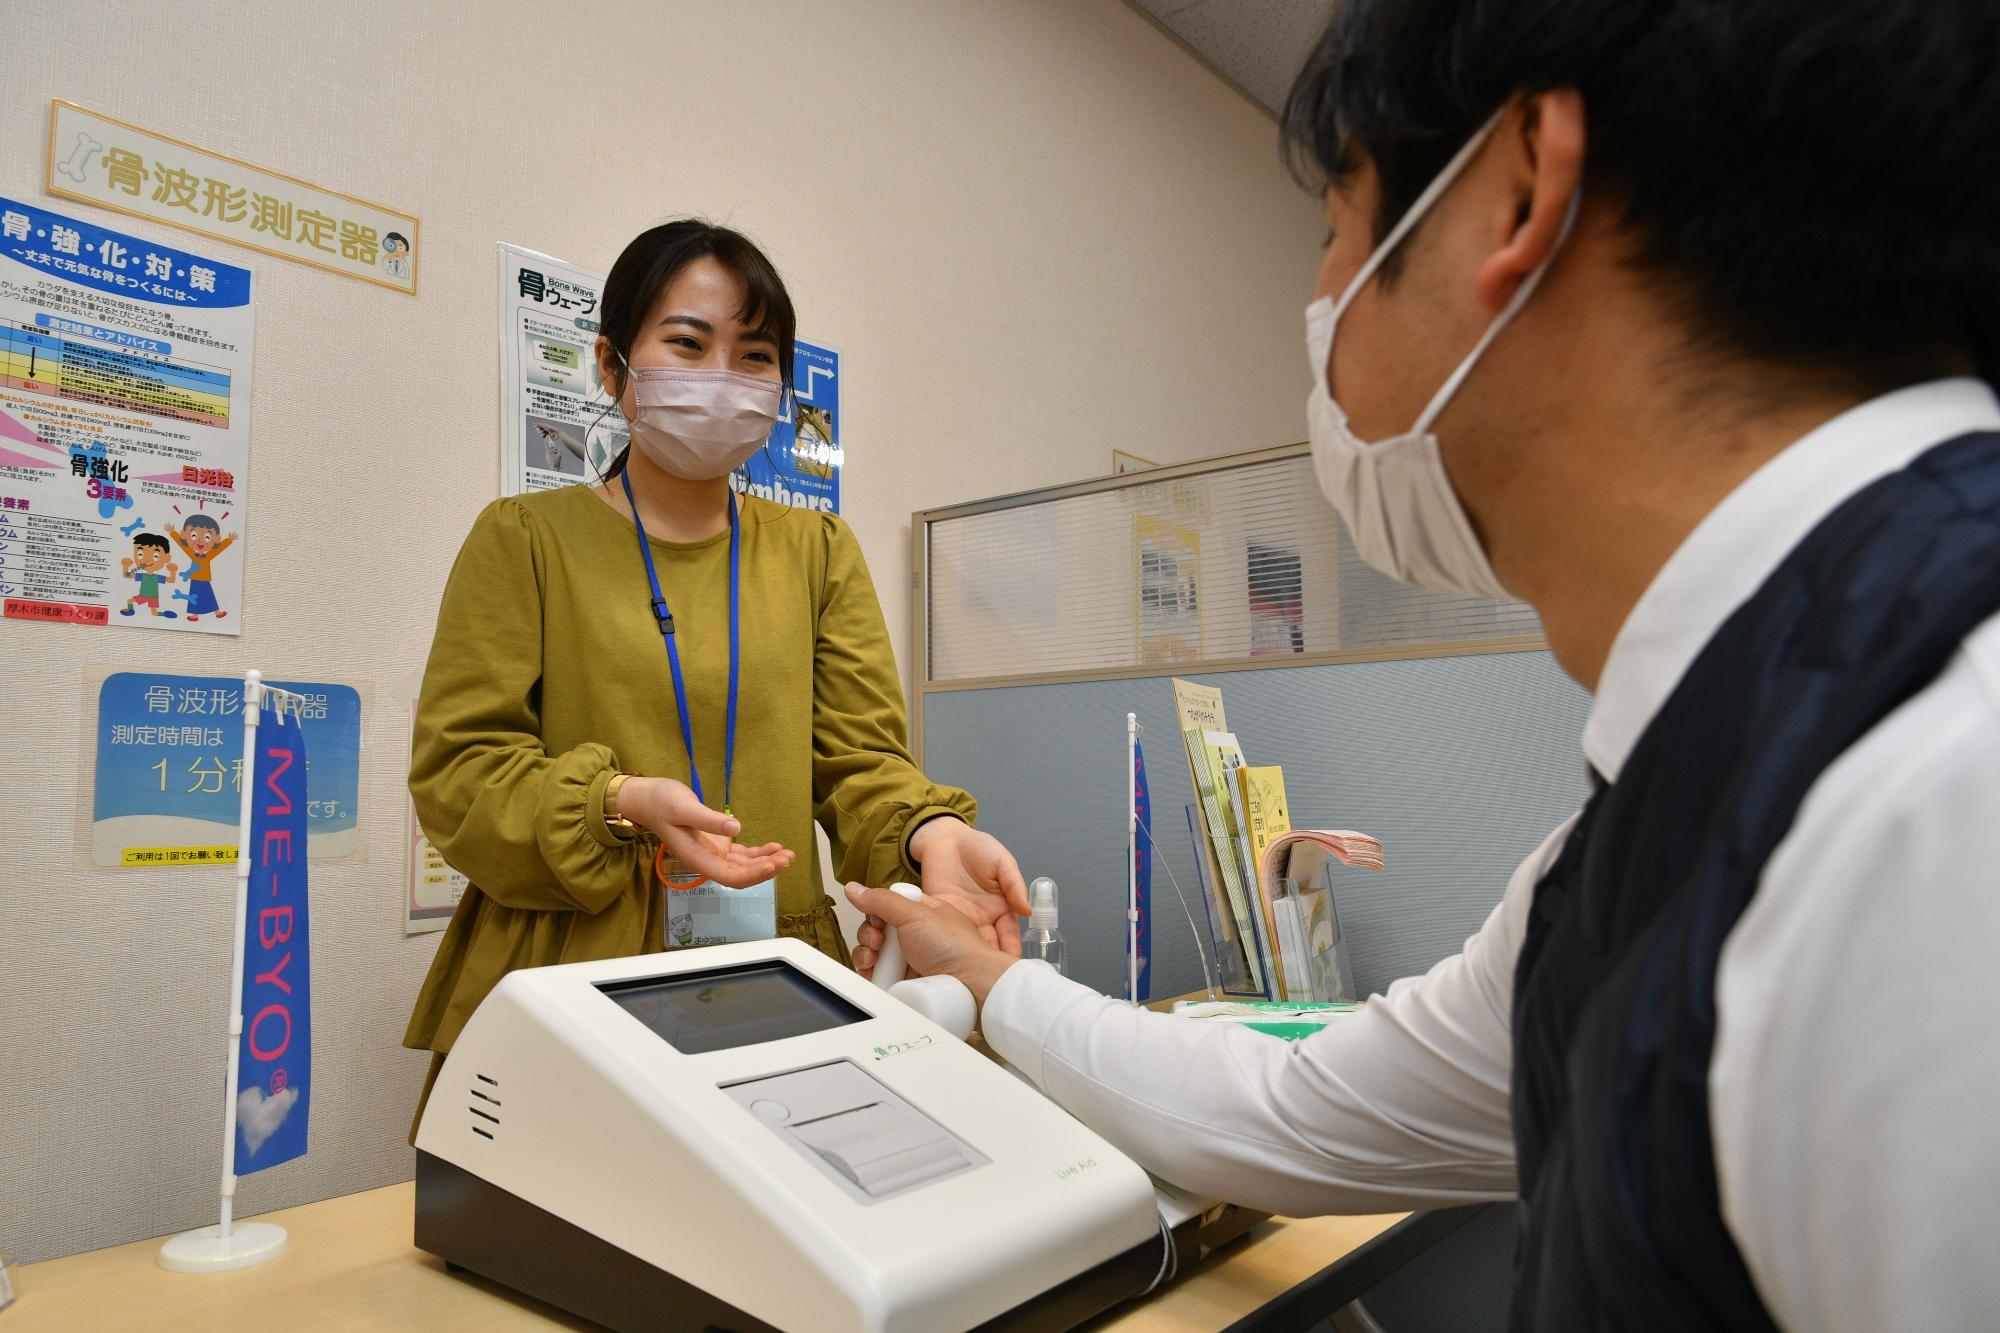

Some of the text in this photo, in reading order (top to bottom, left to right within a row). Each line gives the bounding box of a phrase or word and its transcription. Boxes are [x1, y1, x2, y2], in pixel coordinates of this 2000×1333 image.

[102, 146, 380, 266] 骨波形測定器
[548, 277, 595, 298] Bone Wave
[48, 317, 158, 352] 測定結果とアドバイス
[71, 453, 129, 484] 骨強化
[183, 465, 234, 489] 日光浴
[86, 476, 128, 502] 3要素
[0, 496, 30, 511] 養素
[6, 603, 105, 621] 厚木市健康づくり課
[111, 724, 224, 747] 測定時間は
